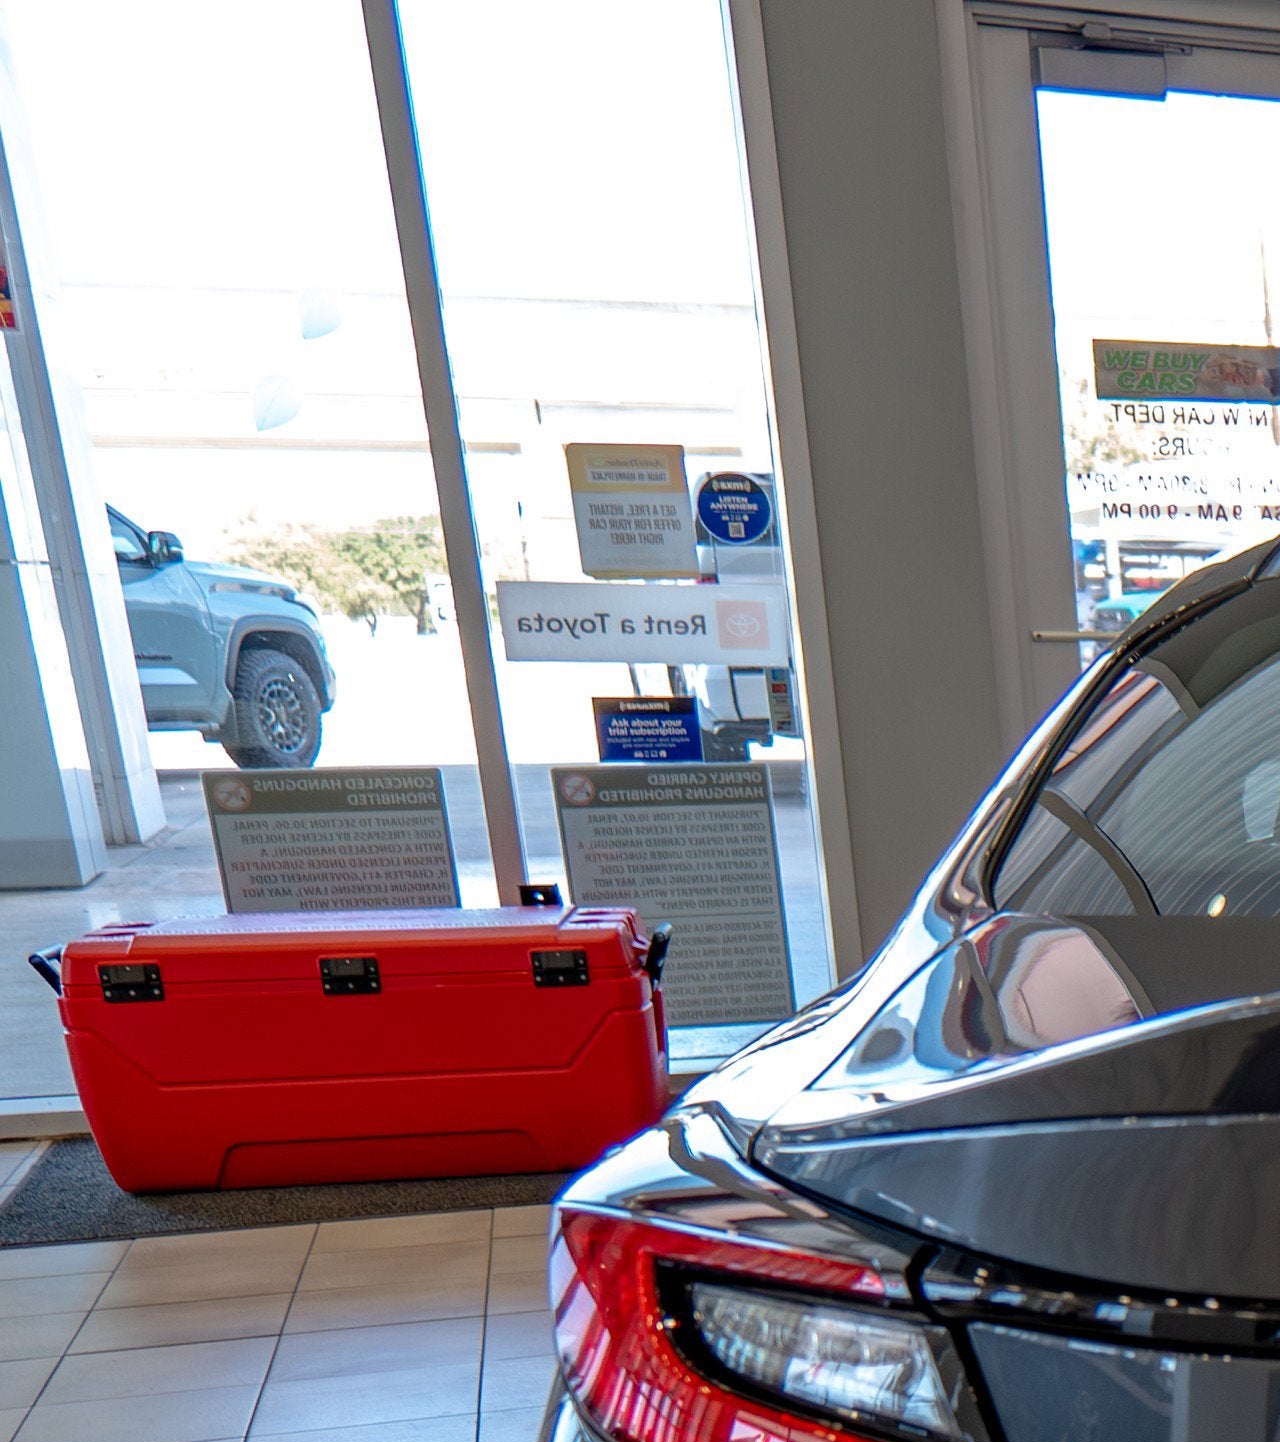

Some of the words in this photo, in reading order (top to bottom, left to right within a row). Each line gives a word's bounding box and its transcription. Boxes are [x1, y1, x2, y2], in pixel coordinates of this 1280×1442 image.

[1103, 350, 1146, 369] WE
[1153, 351, 1210, 371] BUY
[1116, 370, 1198, 393] CARS
[719, 495, 748, 504] LISTEN
[710, 502, 759, 511] ANYWHERE
[611, 718, 629, 728] Ask
[631, 718, 659, 728] about
[661, 719, 683, 729] your
[608, 727, 628, 736] trial
[630, 727, 687, 737] subscription
